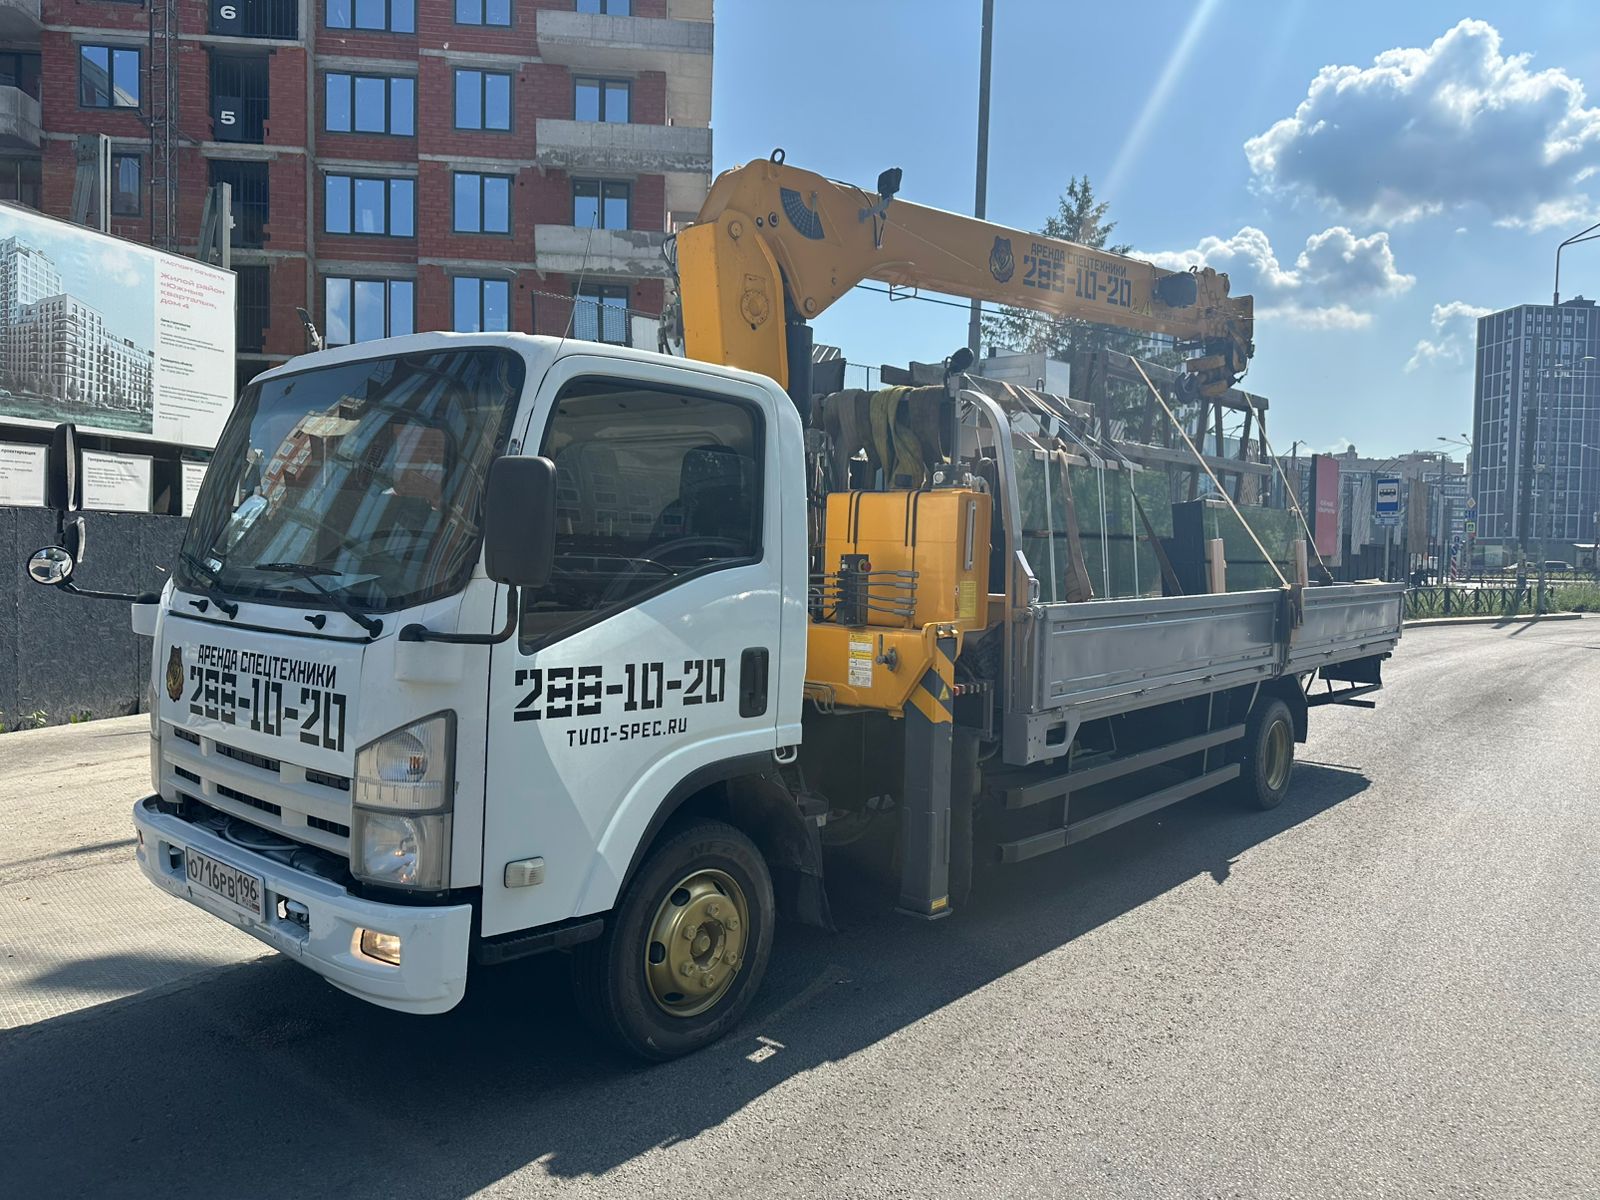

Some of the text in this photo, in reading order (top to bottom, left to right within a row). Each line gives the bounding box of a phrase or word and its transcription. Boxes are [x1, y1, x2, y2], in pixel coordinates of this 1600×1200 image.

[220, 5, 237, 20] 6
[220, 110, 236, 125] 5
[1031, 242, 1127, 277] АРЕНДА СПЕЦТЕХНИКИ
[1022, 255, 1132, 308] 288-10-20
[198, 644, 336, 689] АРЕНДА СПЕЦТЕХНИКИ
[189, 665, 347, 752] 288-10-20
[513, 658, 726, 722] 288-10-20
[567, 717, 687, 747] TVOI-SPEC.RU
